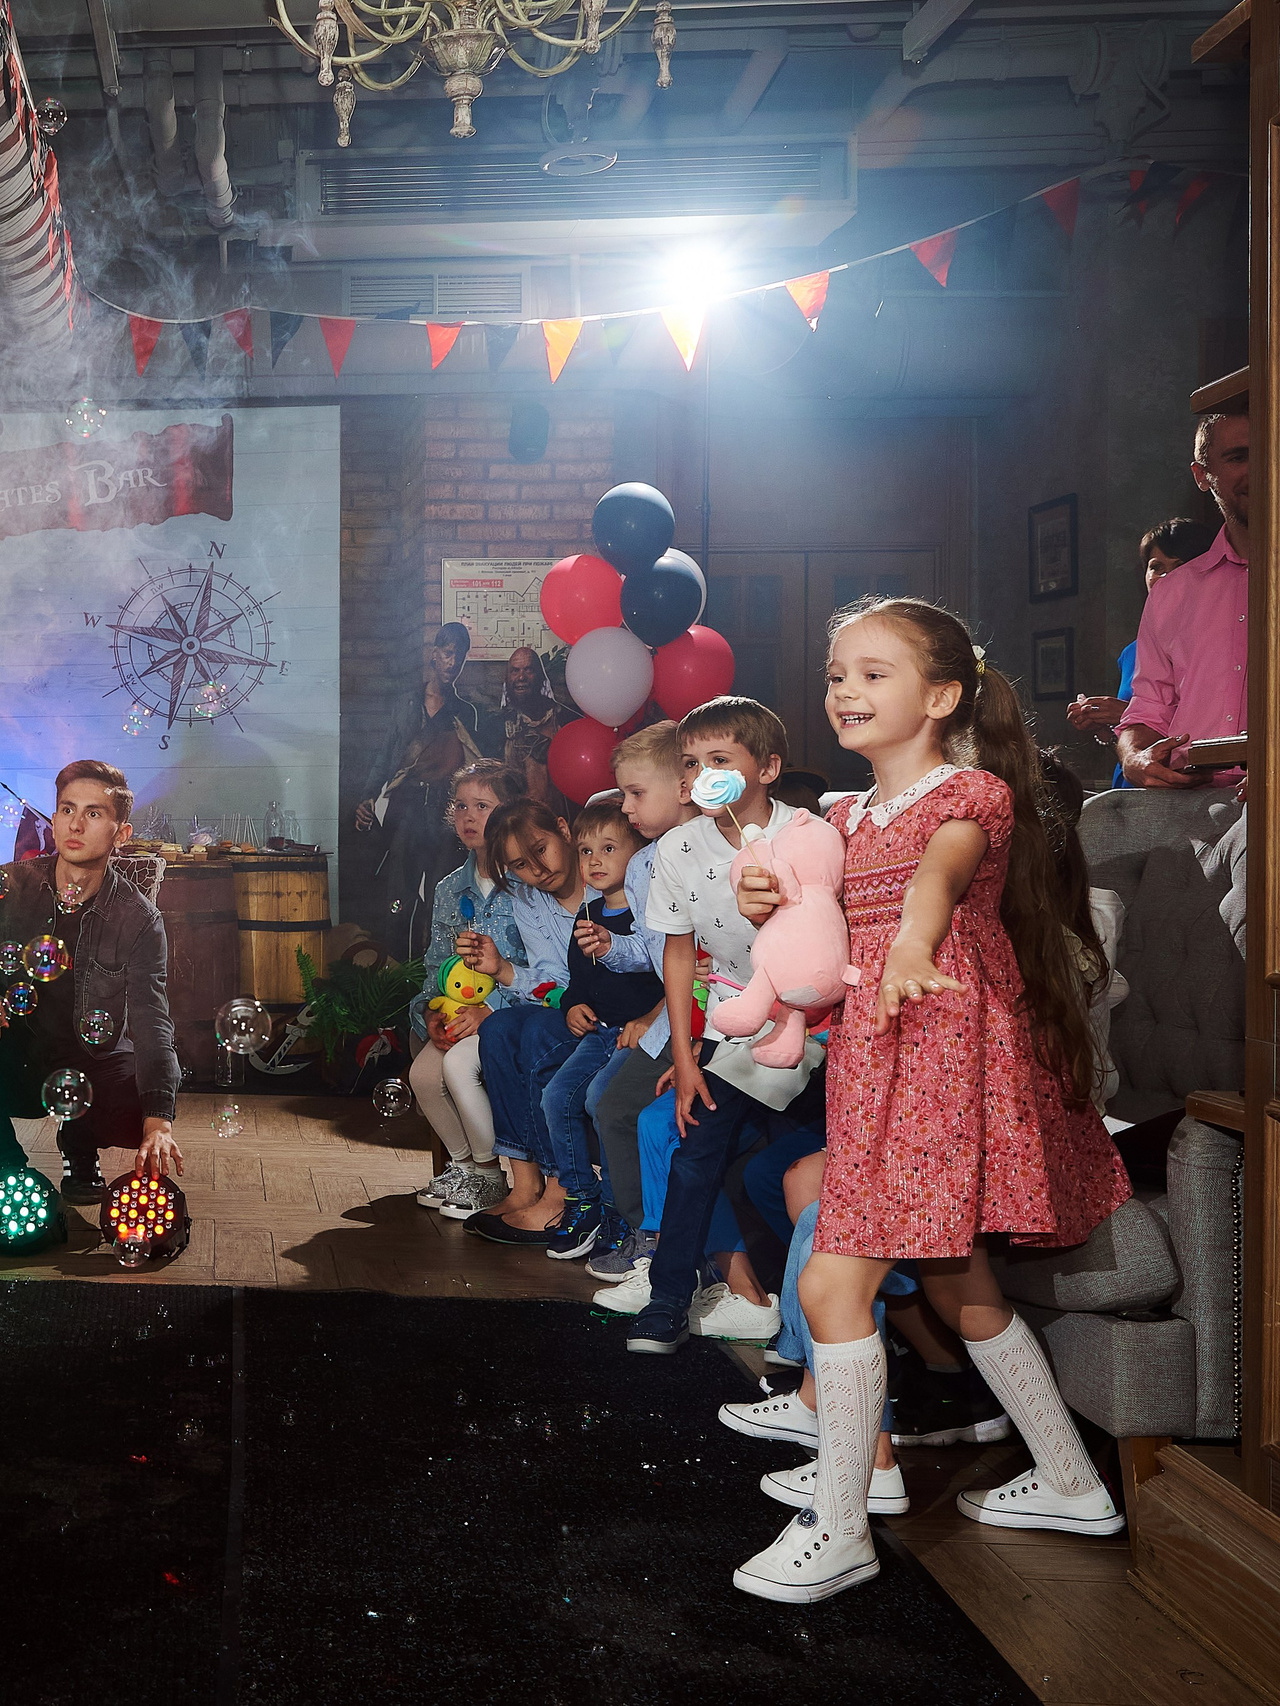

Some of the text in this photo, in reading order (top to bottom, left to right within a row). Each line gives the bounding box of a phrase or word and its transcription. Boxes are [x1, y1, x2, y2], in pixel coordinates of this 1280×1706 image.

[67, 459, 168, 507] BAR
[207, 541, 227, 559] N
[83, 612, 102, 629] W
[158, 734, 171, 750] S
